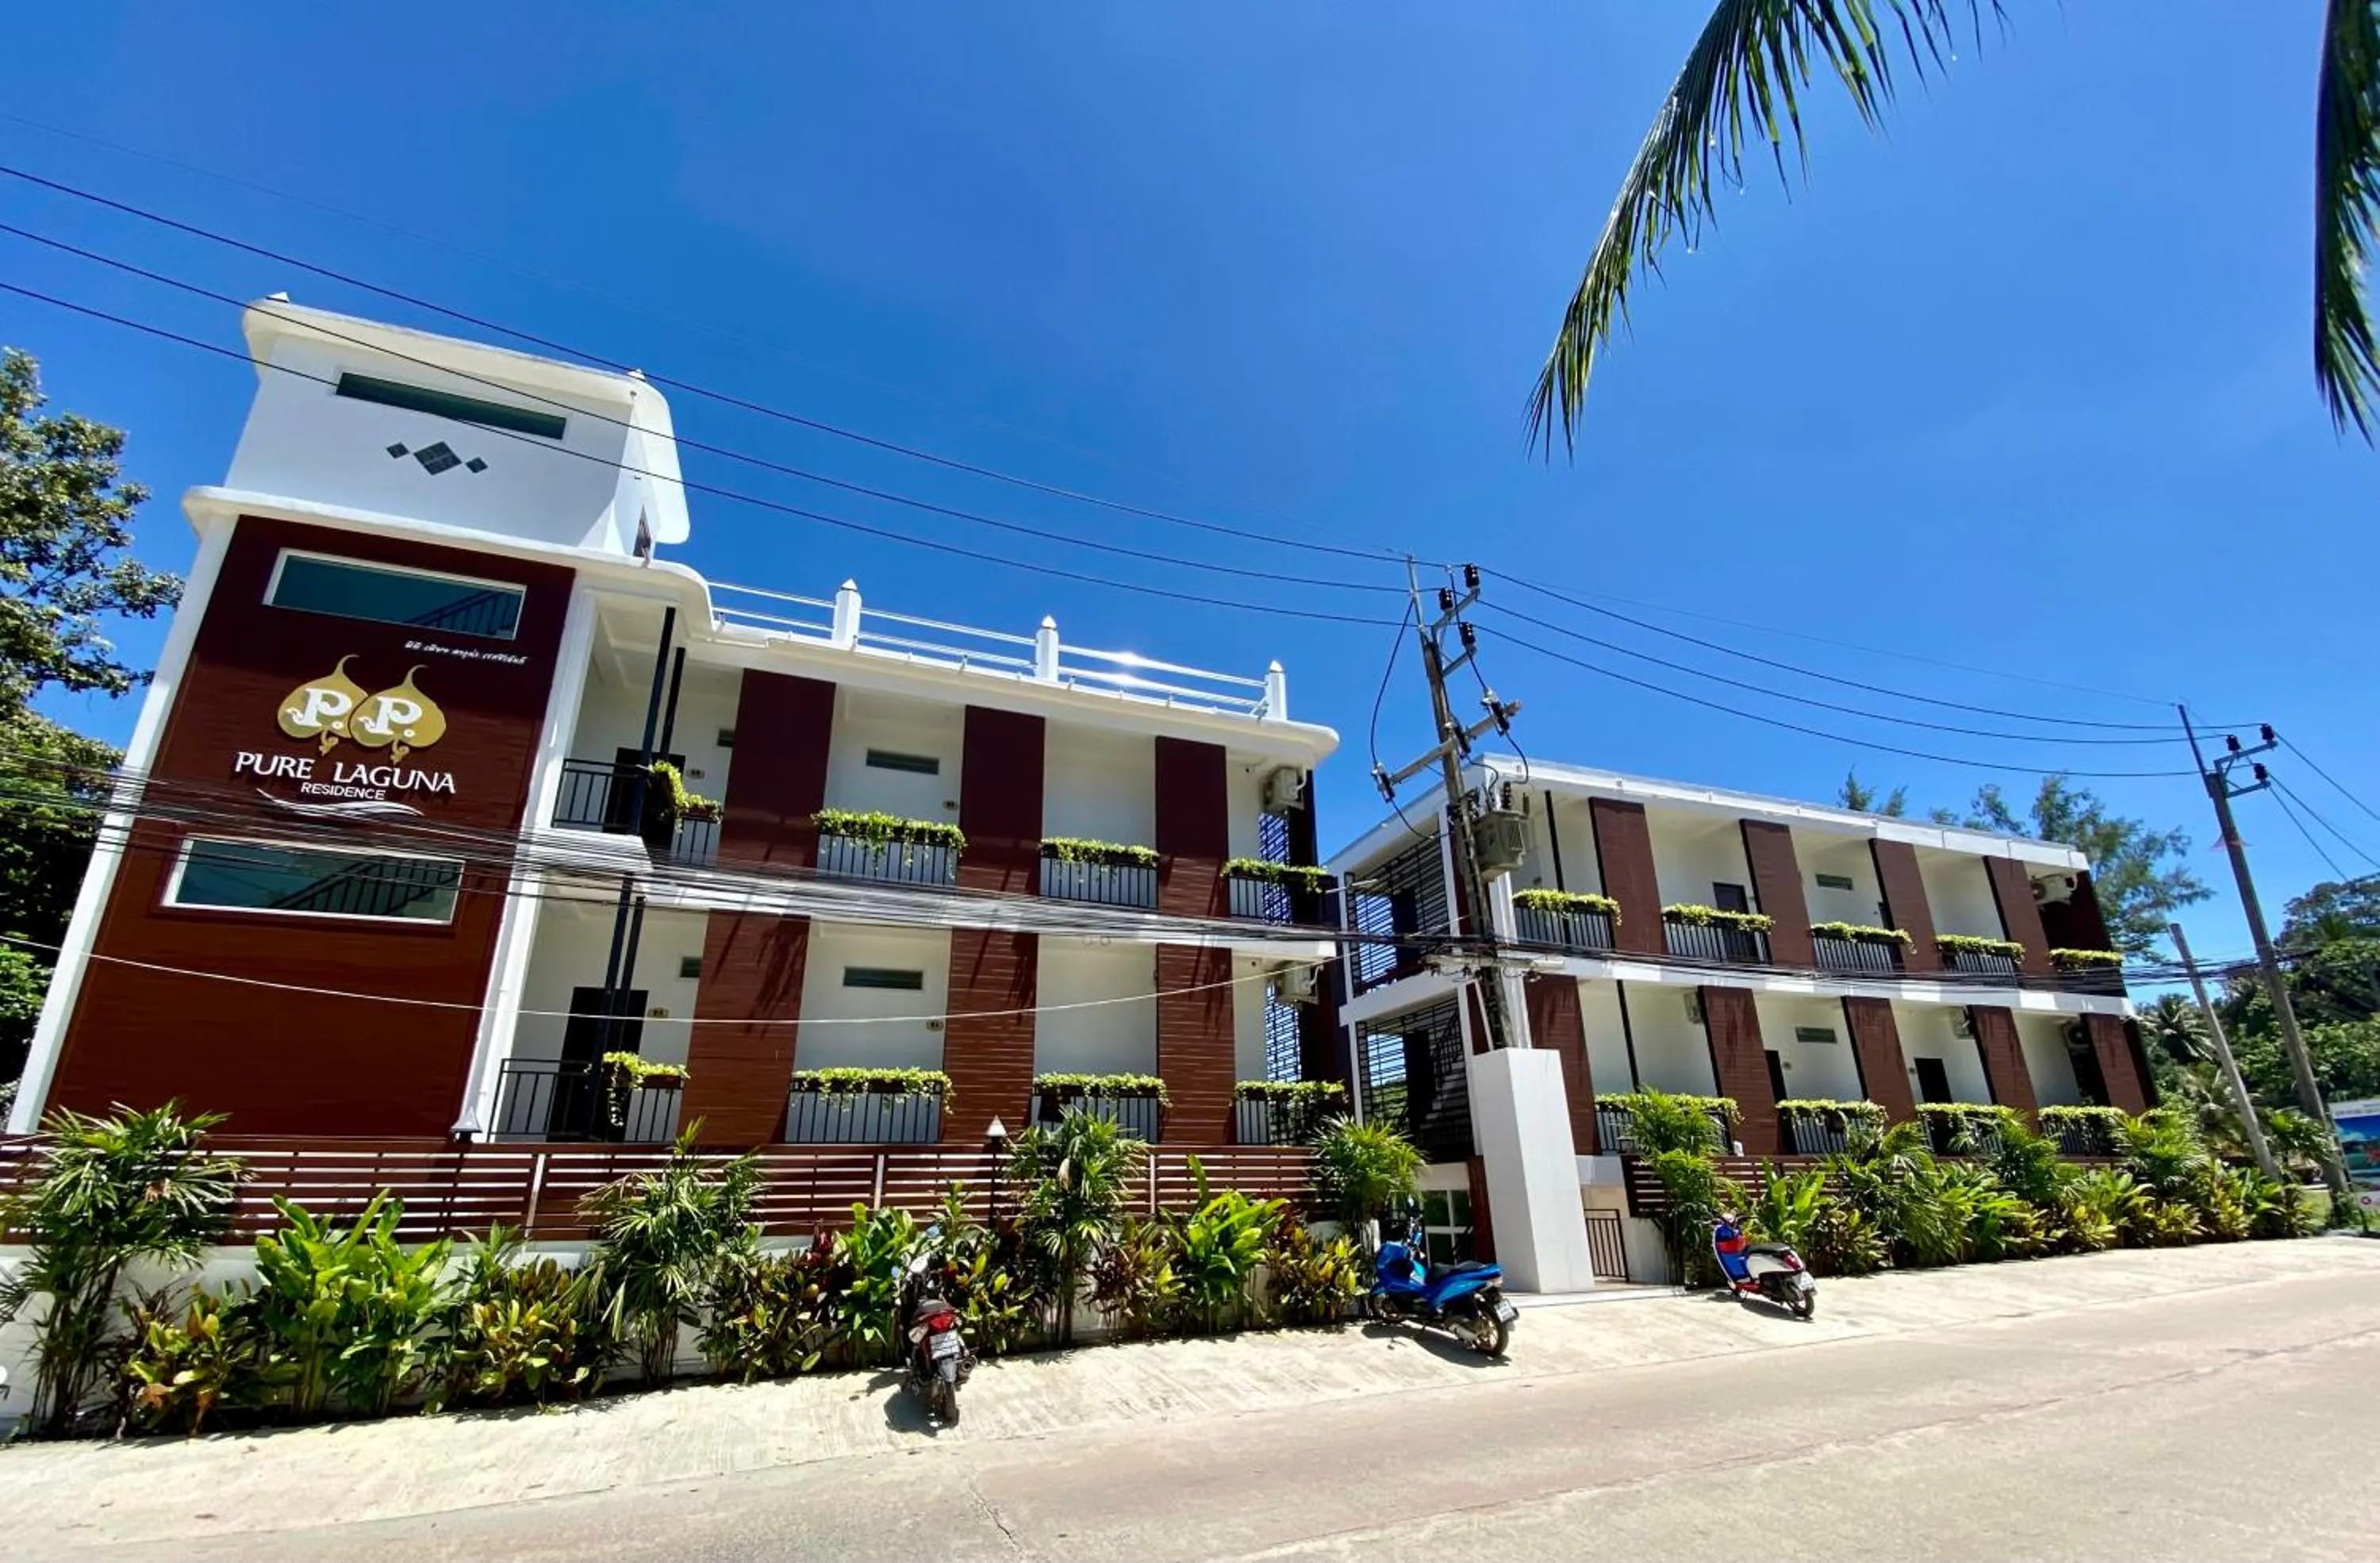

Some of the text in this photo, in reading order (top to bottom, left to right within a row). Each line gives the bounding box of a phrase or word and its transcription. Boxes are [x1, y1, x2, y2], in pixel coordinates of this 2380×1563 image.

[235, 751, 456, 794] PURE LAGUNA
[301, 782, 386, 801] RESIDENCE
